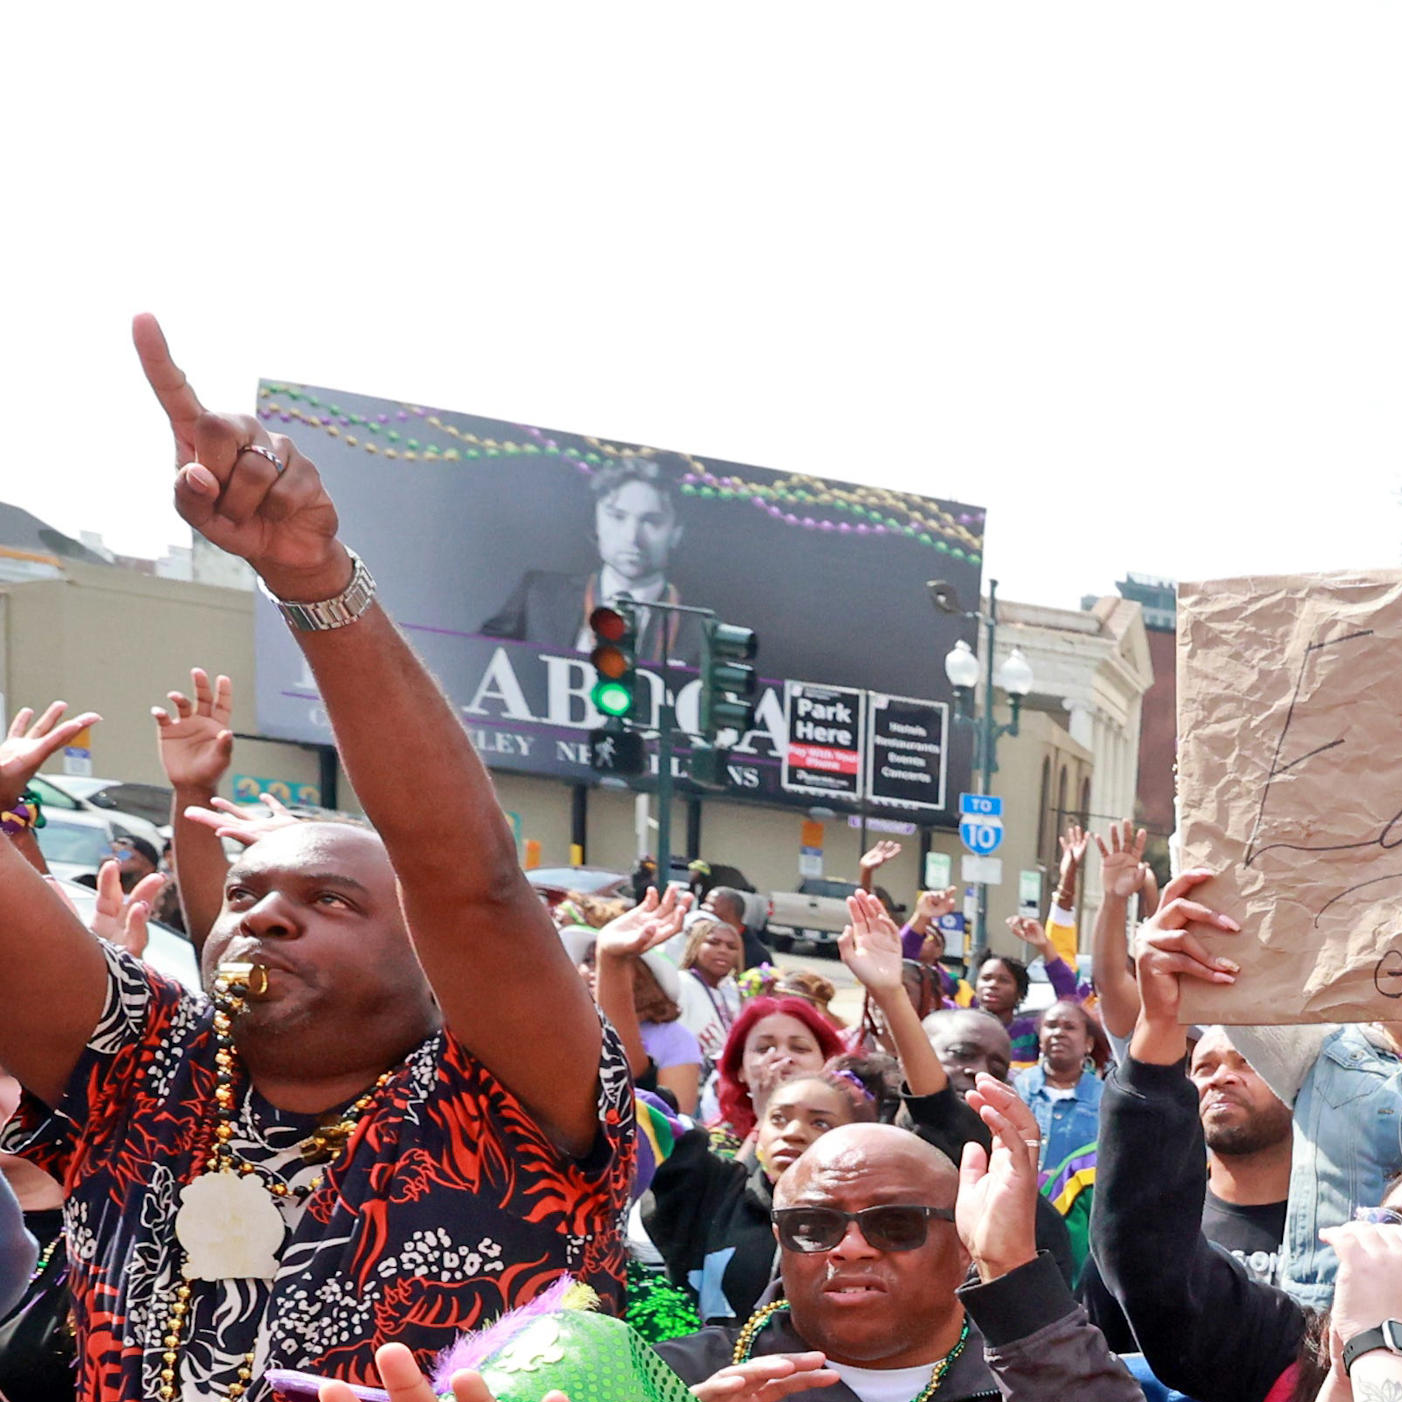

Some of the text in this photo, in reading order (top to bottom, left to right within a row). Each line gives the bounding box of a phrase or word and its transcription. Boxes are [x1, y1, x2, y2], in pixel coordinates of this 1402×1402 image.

[797, 698, 852, 724] Park
[796, 720, 852, 746] Here
[972, 798, 993, 812] TO
[968, 826, 996, 844] 10
